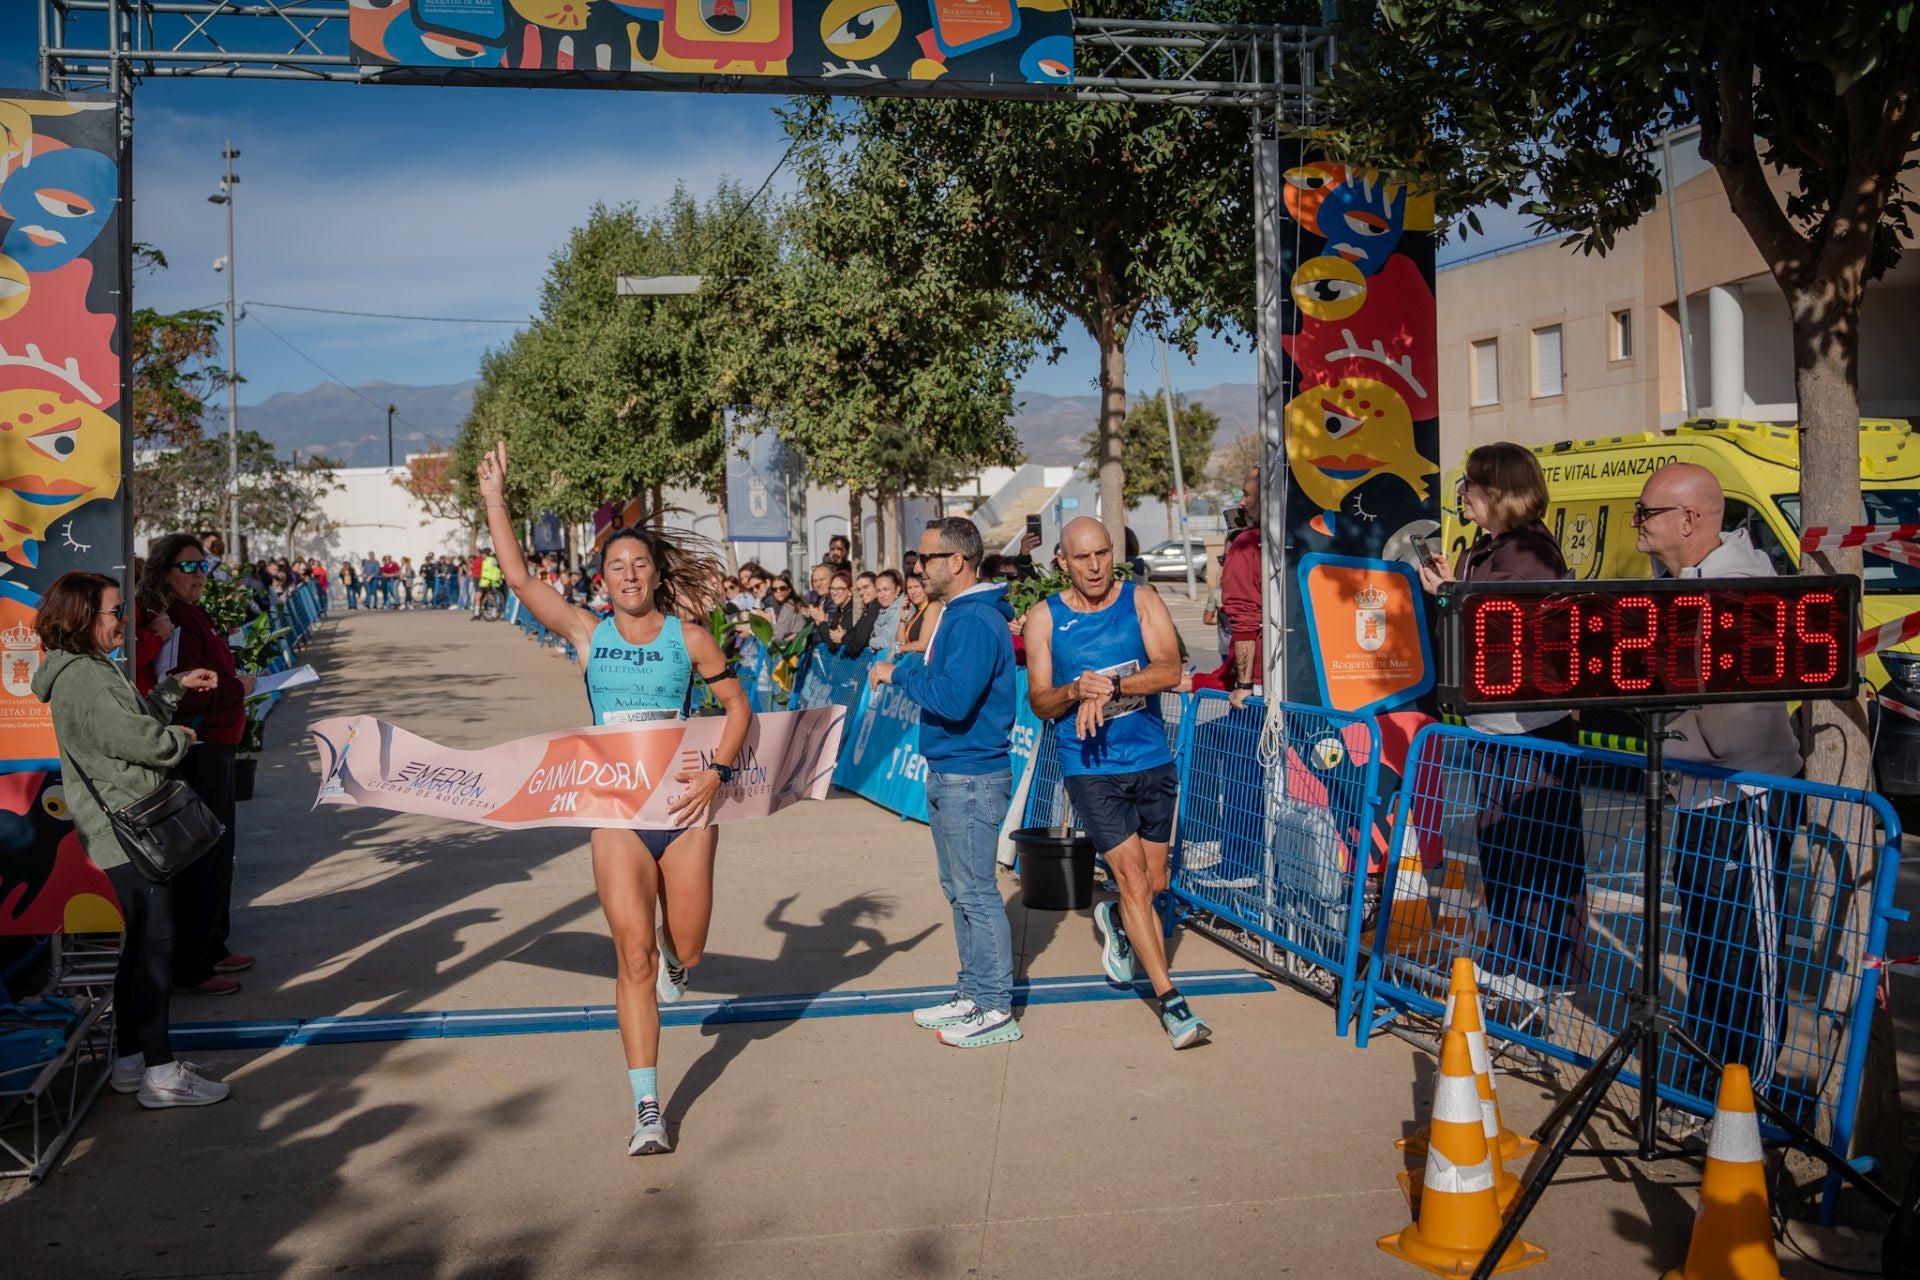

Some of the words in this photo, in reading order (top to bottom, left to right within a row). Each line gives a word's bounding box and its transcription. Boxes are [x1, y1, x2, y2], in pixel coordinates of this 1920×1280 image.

[1564, 463, 1598, 481] VITAL
[1576, 520, 1584, 533] U
[1571, 534, 1586, 549] 24
[1474, 592, 1839, 696] 01:27:15
[593, 647, 664, 667] nerja
[1332, 660, 1374, 670] ROQUETAS
[1376, 660, 1386, 669] DE
[1389, 658, 1409, 668] MAR
[599, 664, 654, 674] ATLETISMO
[30, 708, 41, 716] DE
[627, 711, 657, 723] MEDIA
[416, 764, 483, 787] MEDIA
[528, 759, 652, 794] GANADORA
[367, 780, 411, 794] CIUDAD
[415, 789, 431, 798] DE
[435, 793, 498, 809] ROQUETAS
[549, 791, 579, 813] 21K
